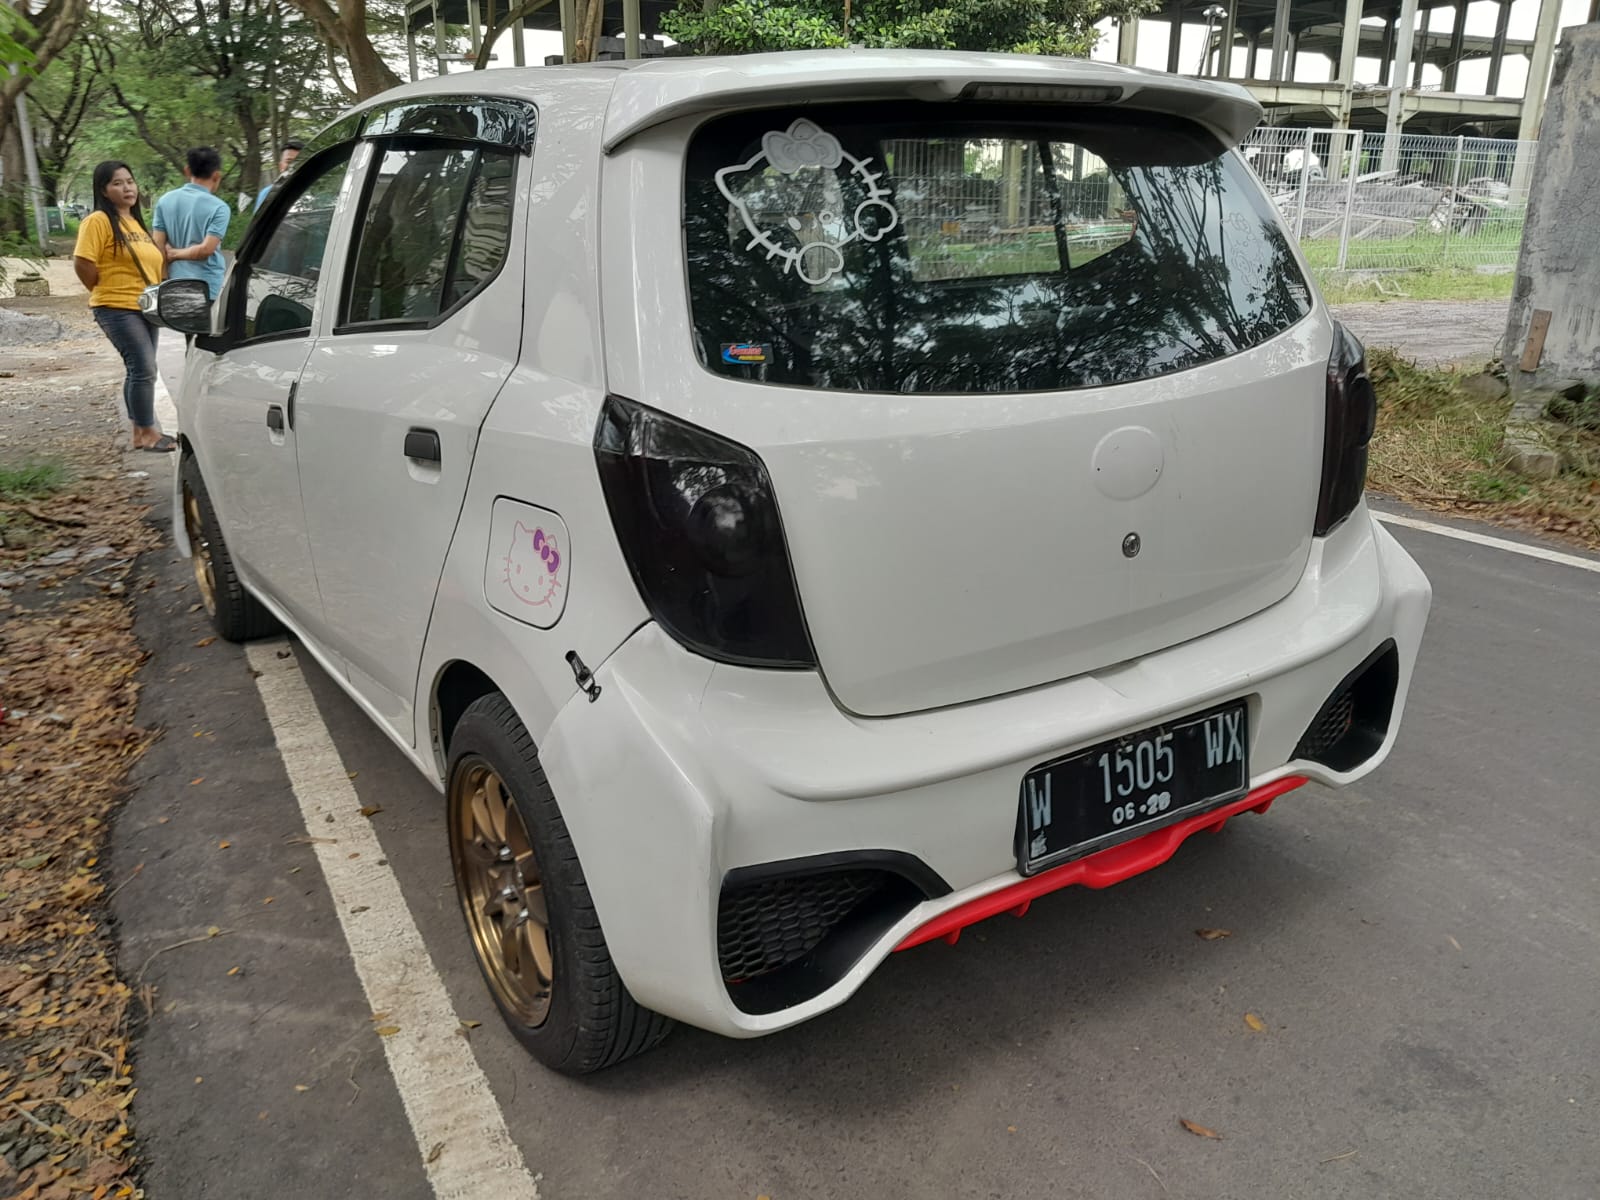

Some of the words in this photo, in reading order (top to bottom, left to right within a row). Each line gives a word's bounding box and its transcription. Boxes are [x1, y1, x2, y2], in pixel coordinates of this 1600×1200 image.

[1029, 772, 1051, 831] W
[1098, 732, 1174, 804] 1505
[1204, 711, 1243, 769] WX
